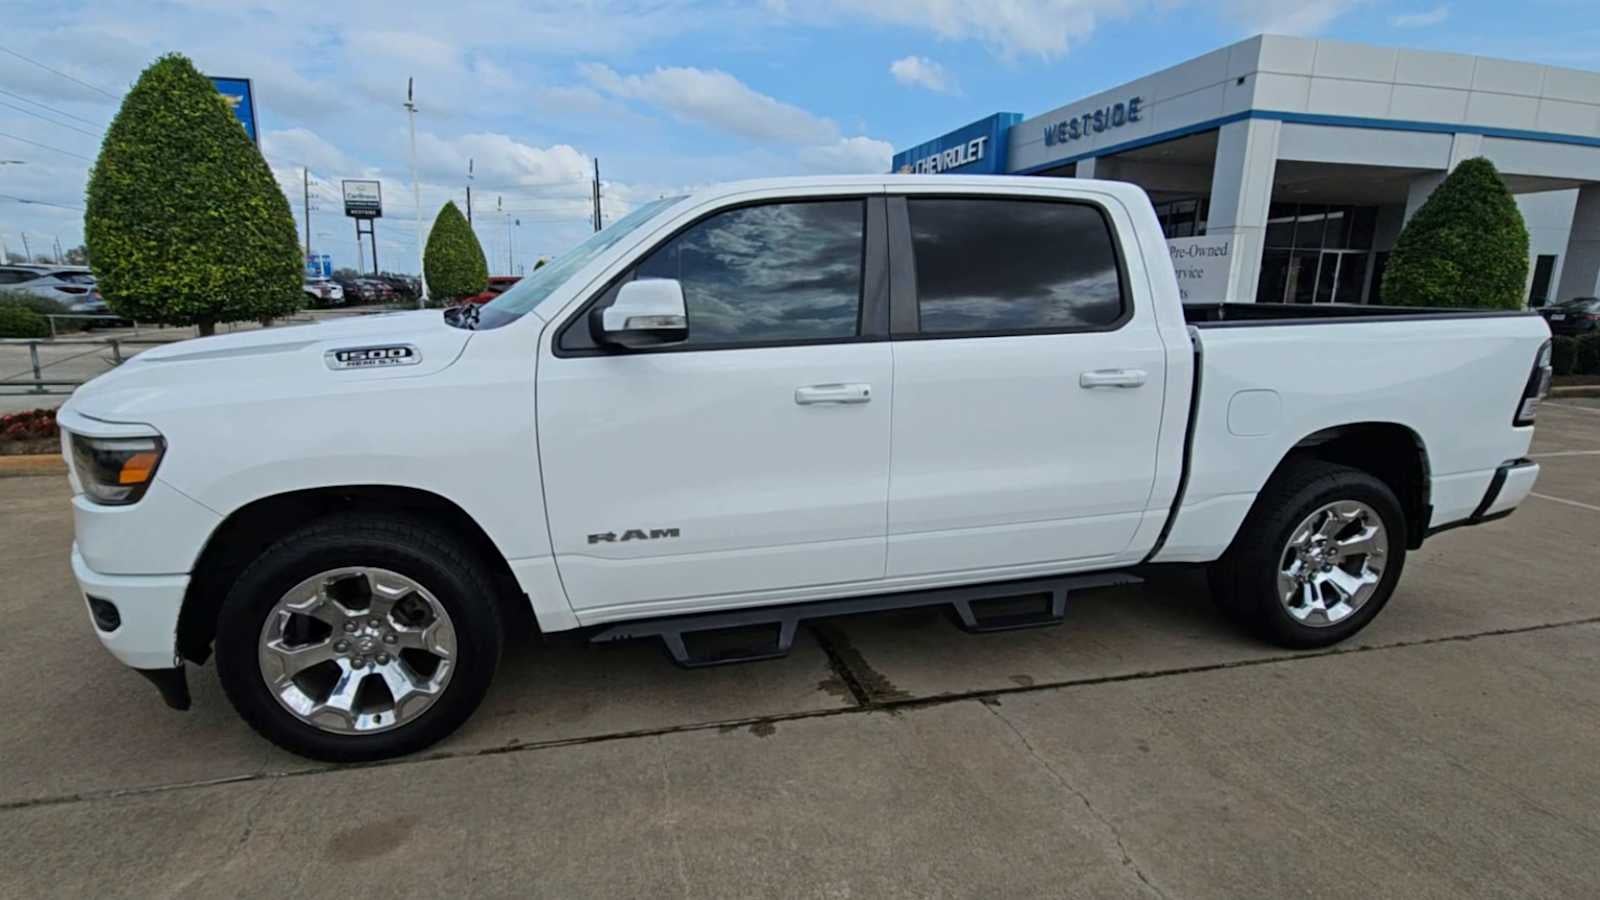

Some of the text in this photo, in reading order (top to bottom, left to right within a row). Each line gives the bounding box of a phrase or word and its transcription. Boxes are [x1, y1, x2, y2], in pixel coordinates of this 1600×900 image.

[1043, 96, 1144, 147] WESTSIDE
[915, 135, 989, 175] CHEVROLET
[1169, 242, 1229, 258] Pre-Owned
[340, 348, 407, 361] 1500
[587, 527, 680, 545] RAM
